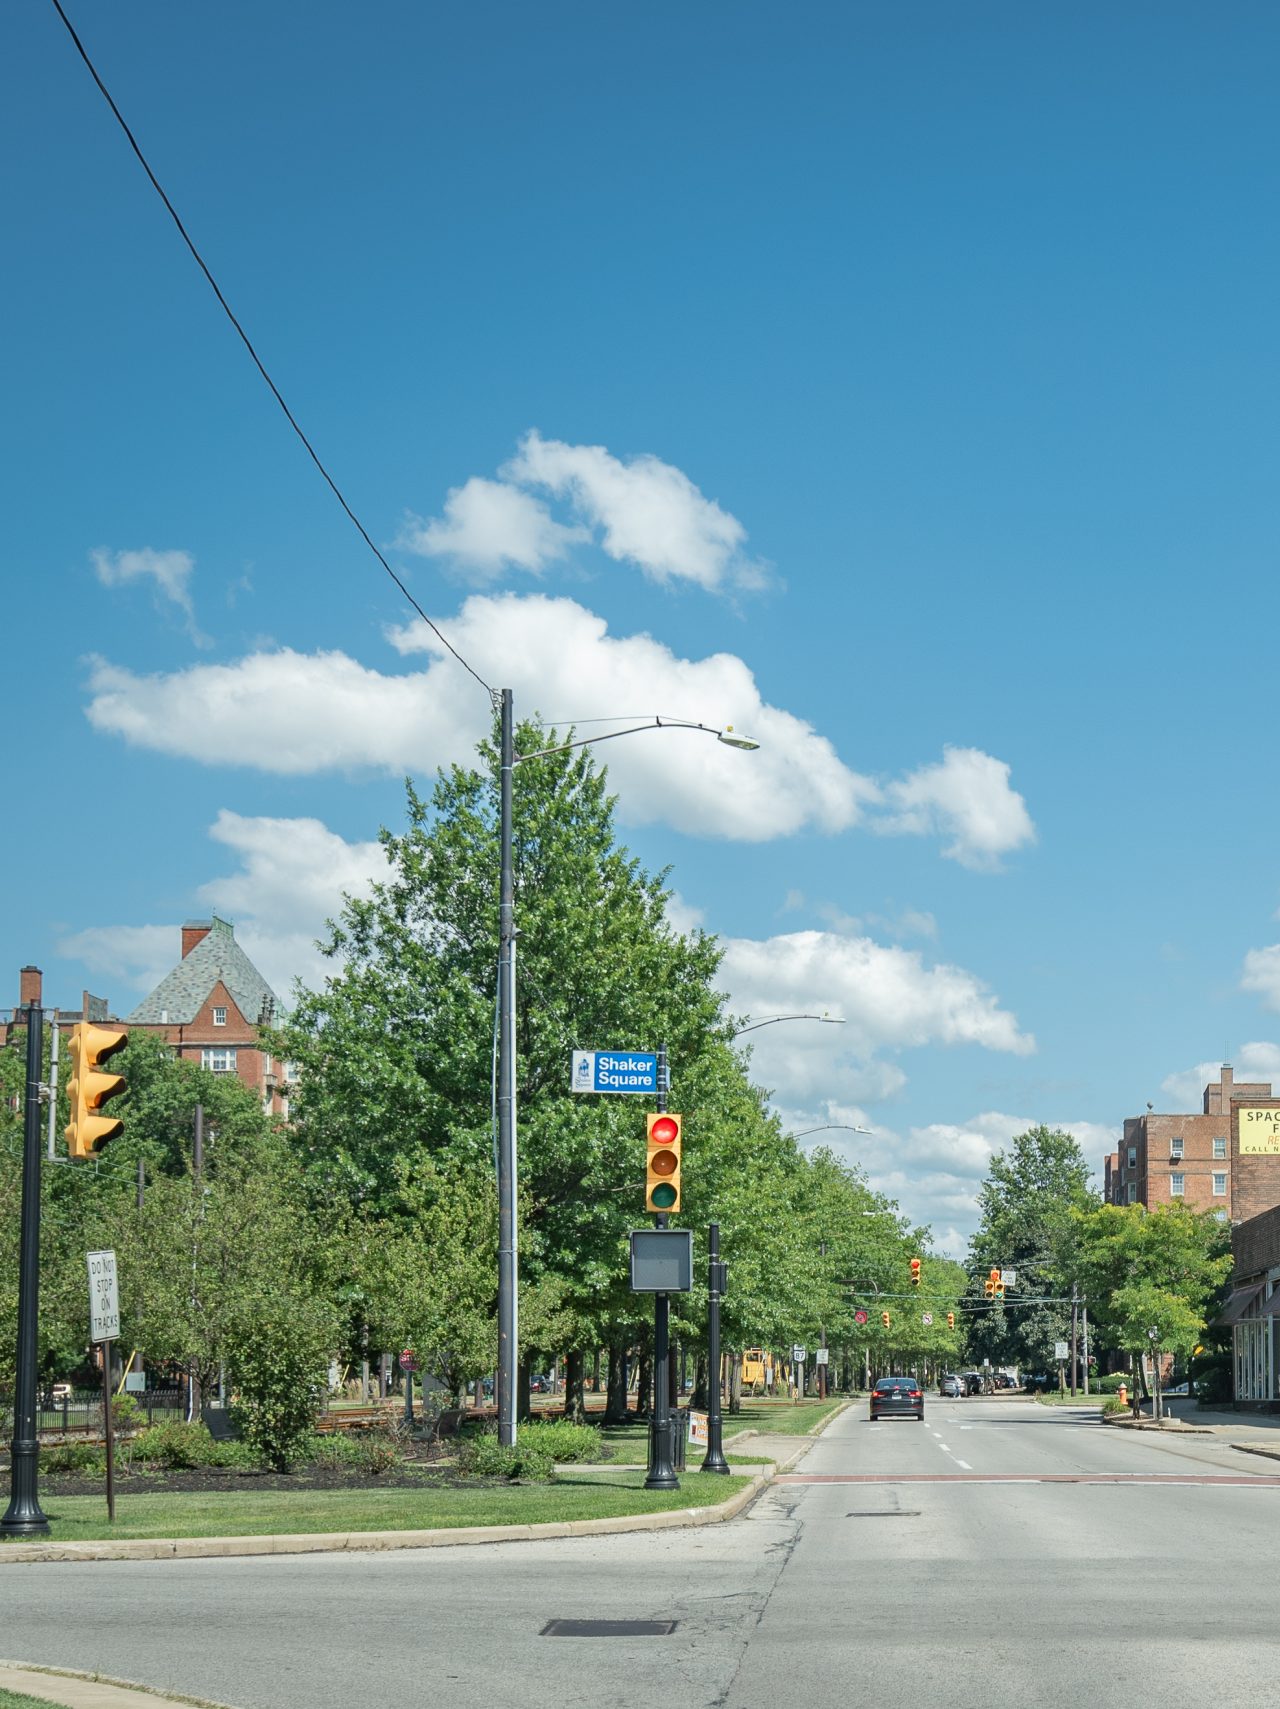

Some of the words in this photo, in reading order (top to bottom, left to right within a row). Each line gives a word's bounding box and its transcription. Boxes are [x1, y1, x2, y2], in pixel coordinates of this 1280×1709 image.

[599, 1057, 653, 1071] Shaker
[598, 1071, 652, 1088] Square
[91, 1262, 100, 1274] DO
[104, 1260, 113, 1272] NOT
[97, 1279, 112, 1293] STOP
[101, 1298, 110, 1311] ON
[94, 1315, 117, 1331] TRACKS
[795, 1352, 805, 1360] 87
